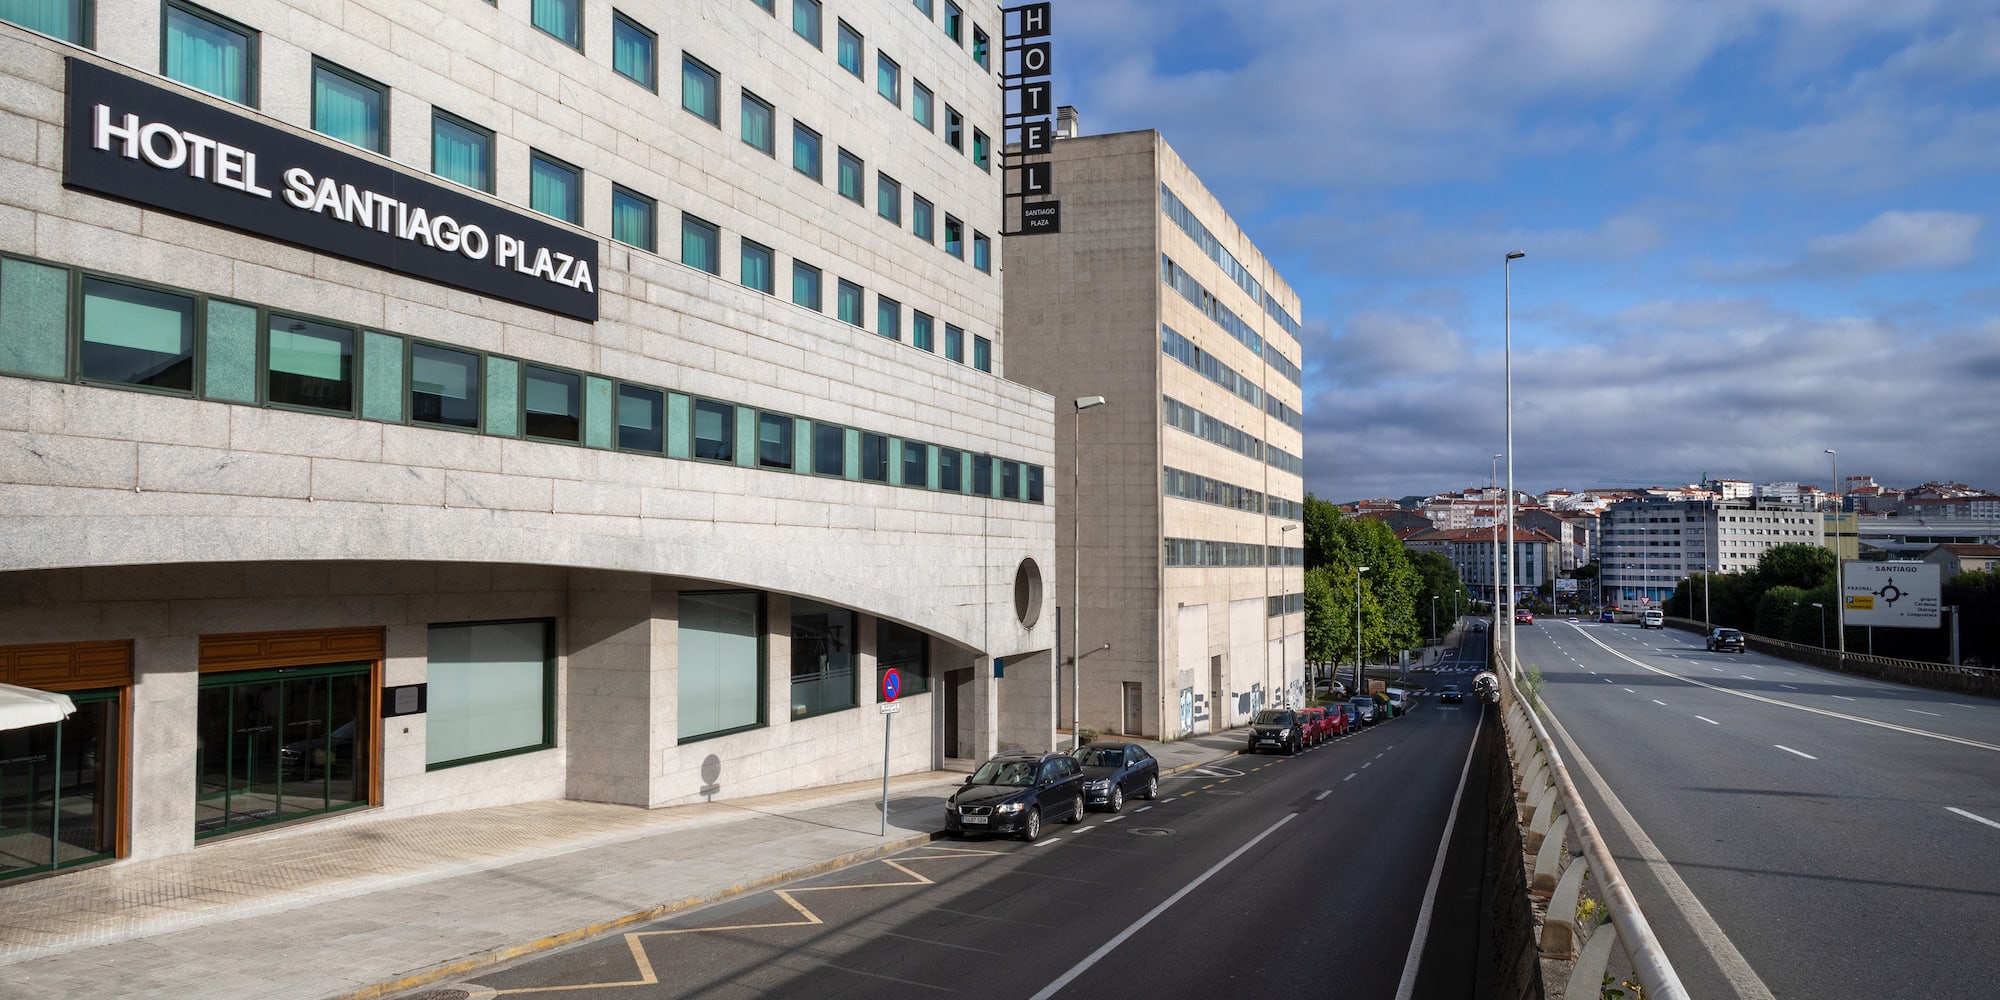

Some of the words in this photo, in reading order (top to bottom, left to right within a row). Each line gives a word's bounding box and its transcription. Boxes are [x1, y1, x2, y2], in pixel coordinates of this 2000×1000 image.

[1025, 8, 1045, 190] HOTEL
[93, 103, 273, 199] HOTEL
[282, 167, 489, 261] SANTIAGO
[495, 233, 594, 294] PLAZA
[1025, 208, 1055, 217] SANTIAGO
[1030, 219, 1049, 227] PLAZA
